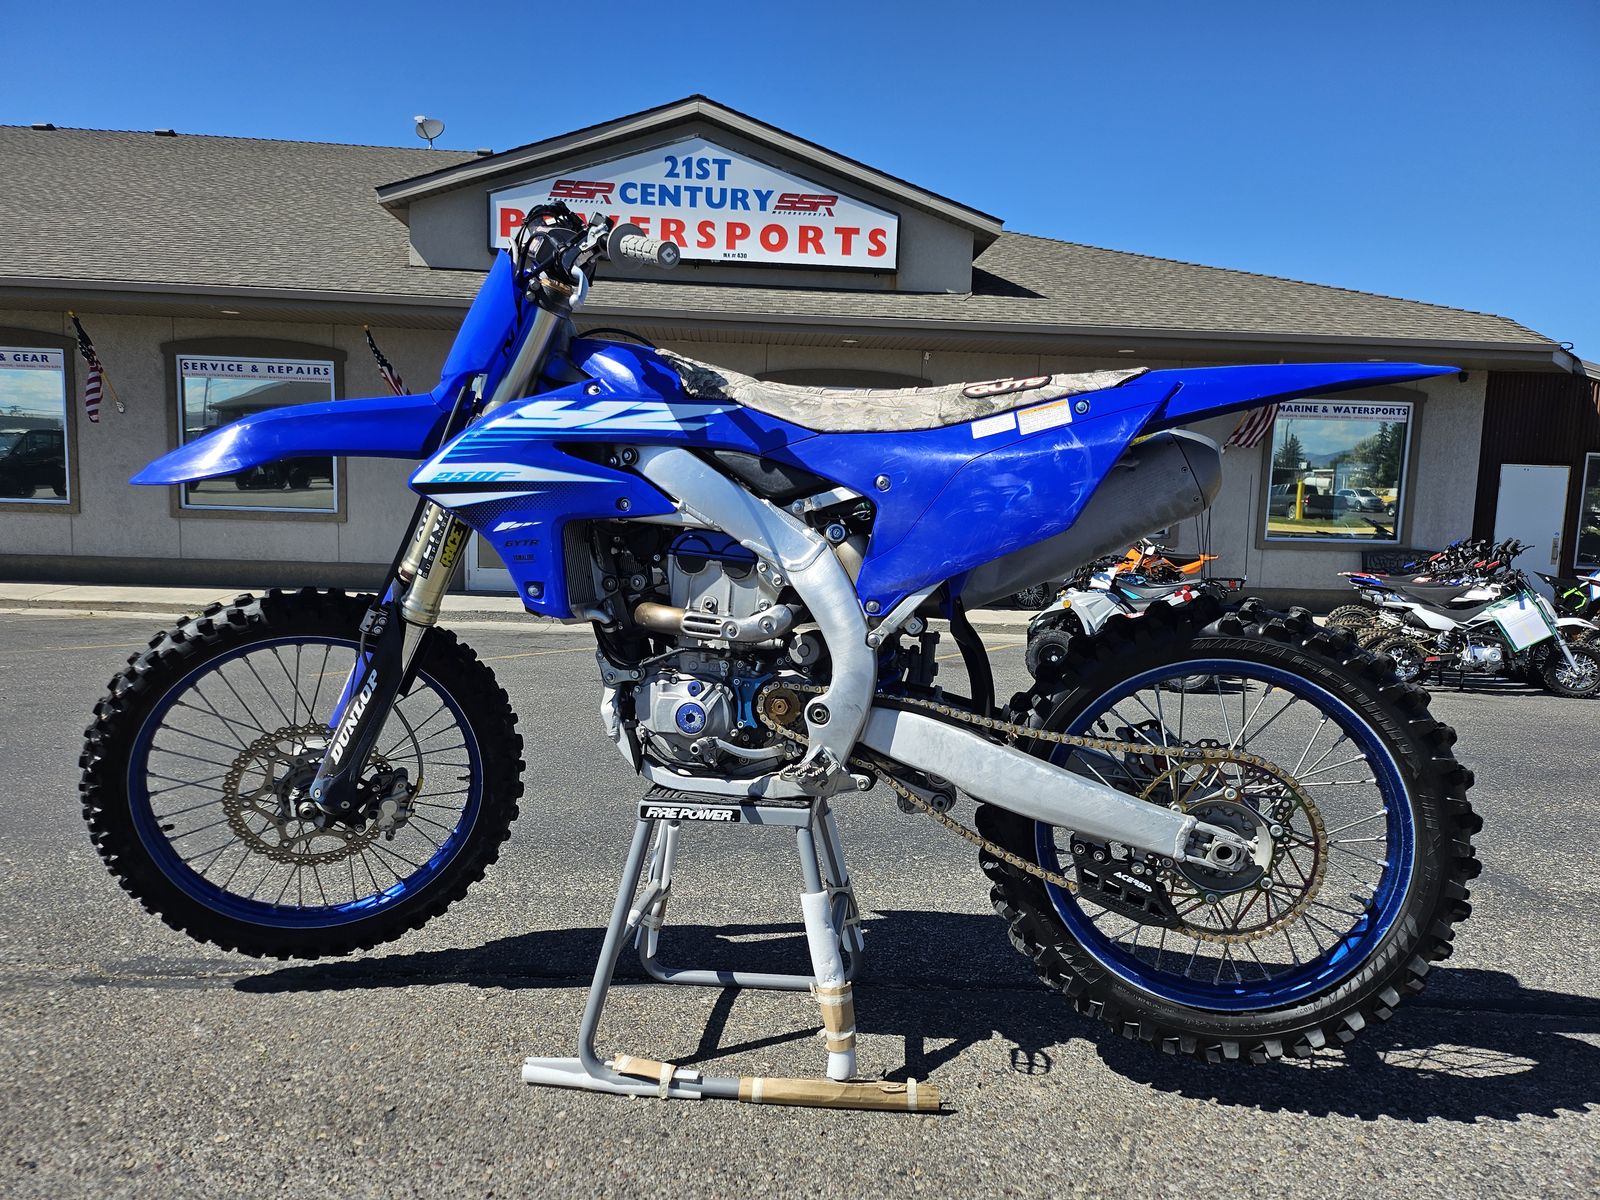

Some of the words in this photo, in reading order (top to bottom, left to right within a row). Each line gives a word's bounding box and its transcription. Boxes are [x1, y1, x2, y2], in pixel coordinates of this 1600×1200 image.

[664, 155, 731, 180] 21ST
[549, 179, 616, 205] SSR
[619, 182, 775, 212] CENTURY
[774, 192, 839, 217] SSR
[500, 207, 887, 258] PERSPORTS
[13, 353, 49, 363] GEAR
[183, 362, 243, 372] SERVICE
[251, 364, 259, 373] &
[267, 365, 330, 376] REPAIRS
[965, 376, 1049, 395] GUTS
[1279, 404, 1318, 413] MARINE
[1321, 405, 1329, 413] &
[1333, 405, 1407, 416] WATERSPORTS
[430, 471, 521, 482] 250F
[330, 668, 378, 766] DUNLOP
